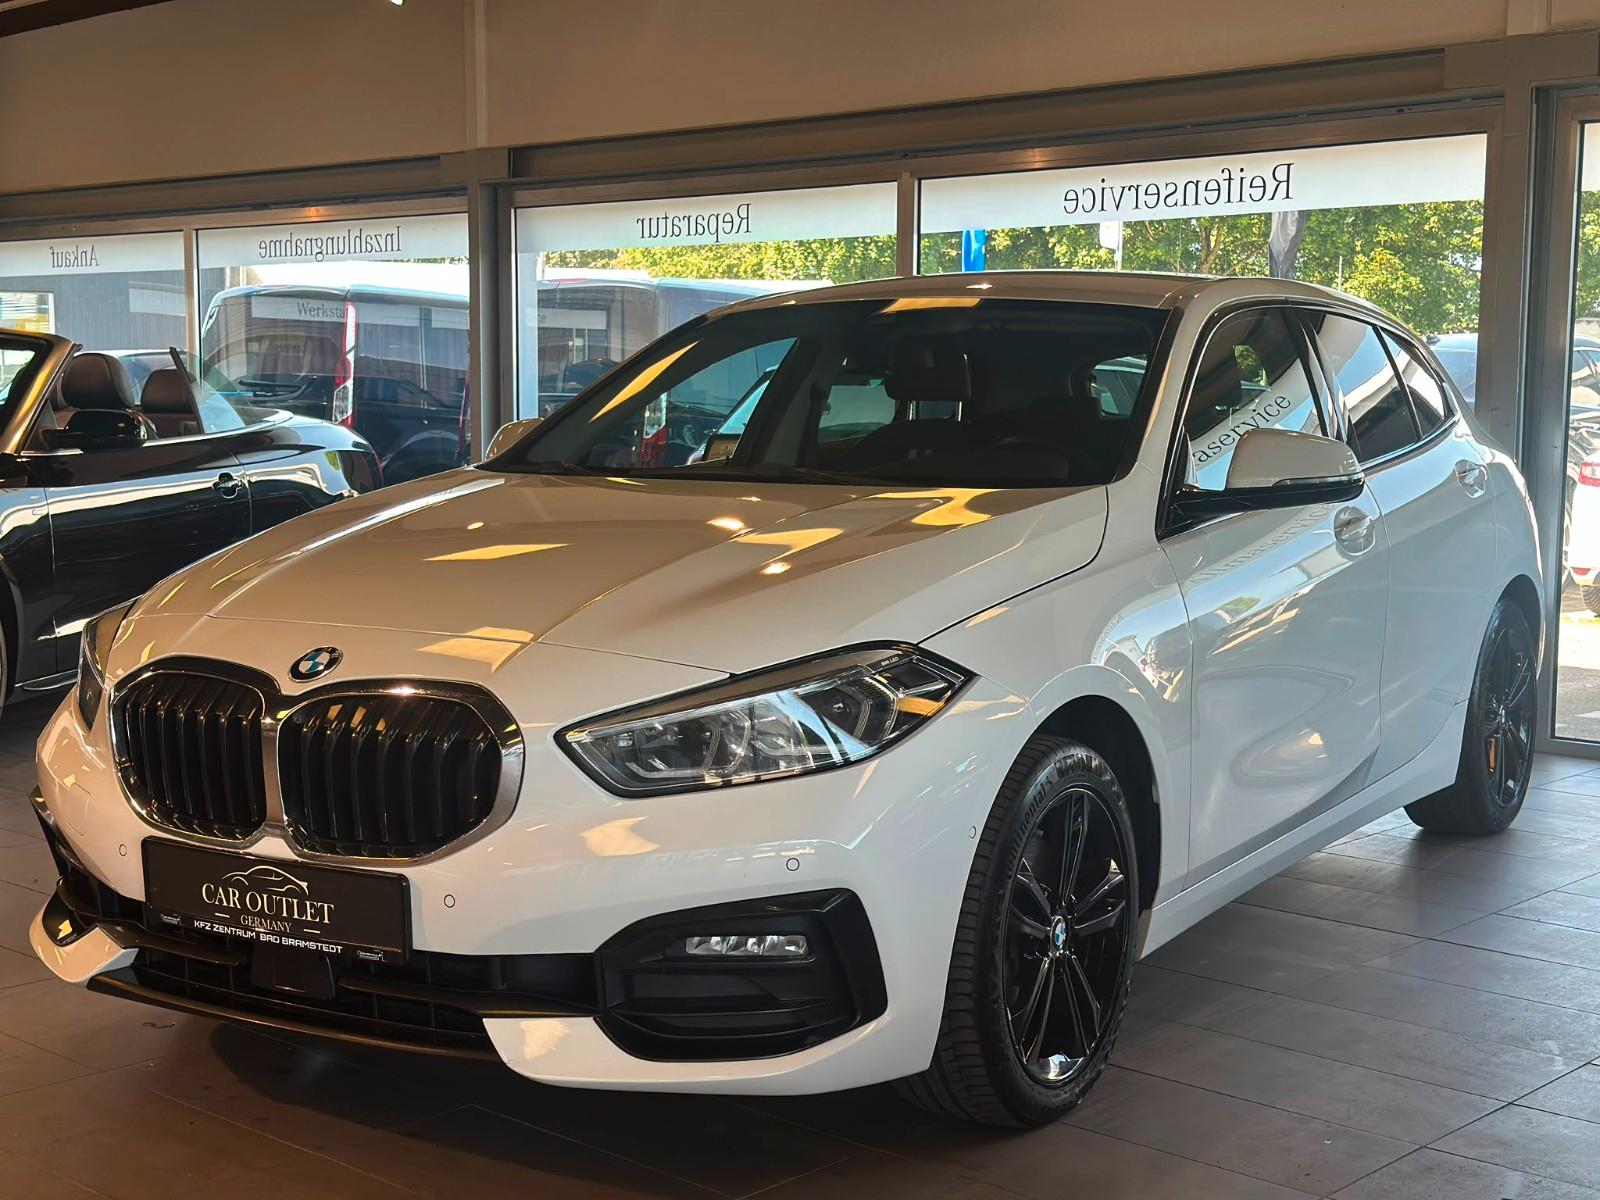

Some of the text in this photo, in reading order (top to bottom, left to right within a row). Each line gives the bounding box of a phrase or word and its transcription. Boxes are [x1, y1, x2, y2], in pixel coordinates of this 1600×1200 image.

[201, 882, 335, 924] CAR OUTLET
[194, 920, 343, 954] KFZ ZENTRUM BAD BRAMSTEDT
[240, 914, 292, 933] GERMANY
